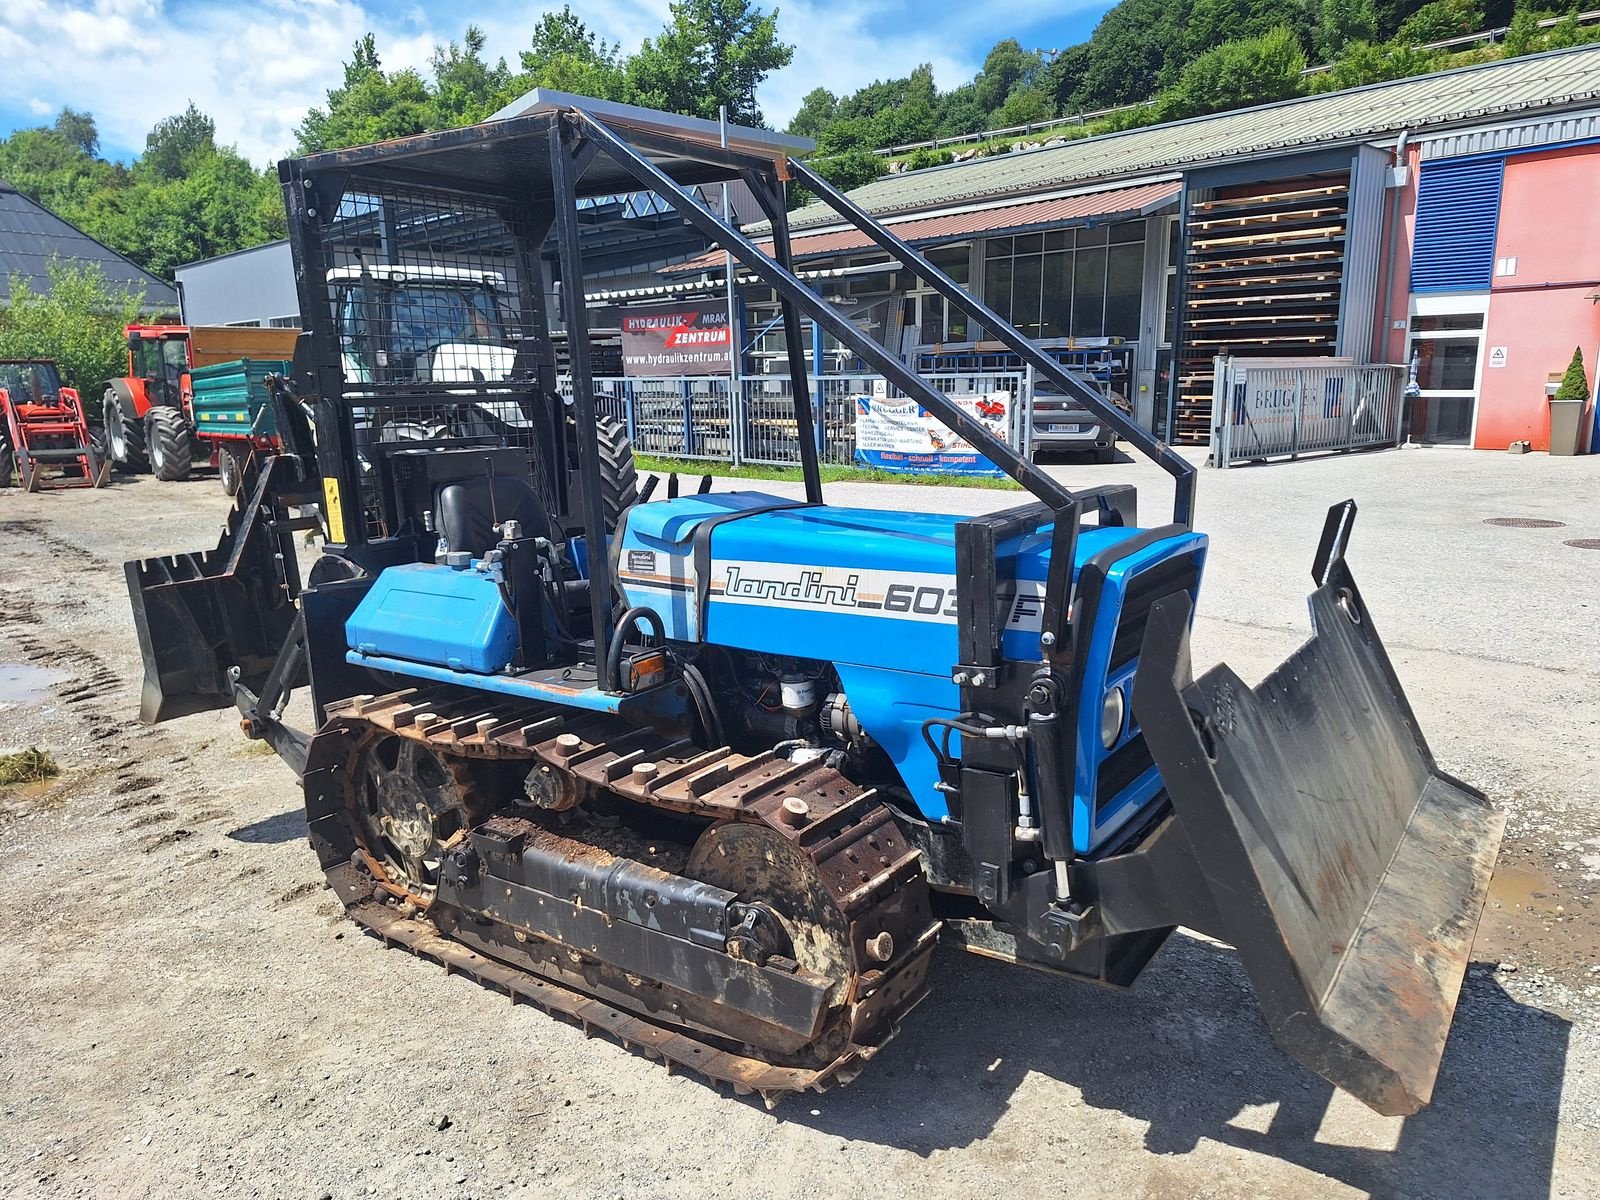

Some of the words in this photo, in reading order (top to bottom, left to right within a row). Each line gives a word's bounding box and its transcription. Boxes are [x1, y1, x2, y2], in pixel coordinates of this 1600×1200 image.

[629, 316, 687, 328] HYDRAULIK-
[702, 313, 727, 324] MRAK
[675, 331, 726, 344] ZENTRUM
[626, 351, 732, 366] www.hydraulikzentrum.at
[725, 566, 859, 607] landini
